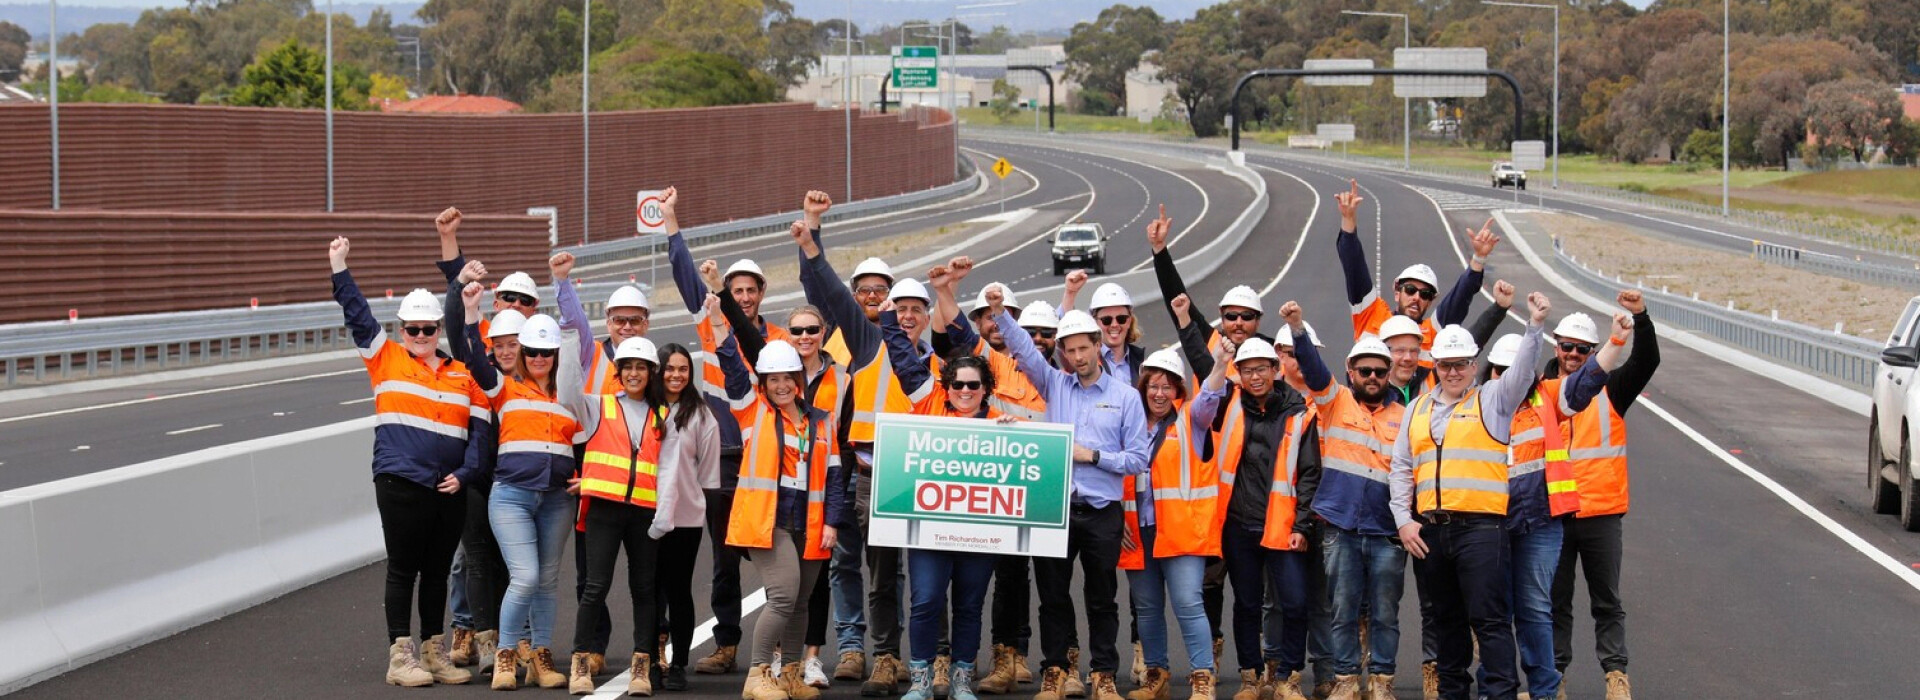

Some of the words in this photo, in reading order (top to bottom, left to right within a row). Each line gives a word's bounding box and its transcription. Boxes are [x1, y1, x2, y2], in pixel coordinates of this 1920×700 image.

[908, 431, 1039, 459] Mordialloc
[904, 452, 1013, 483] Freeway
[1020, 459, 1041, 481] is
[916, 482, 1024, 516] OPEN!
[948, 534, 988, 544] Richardson
